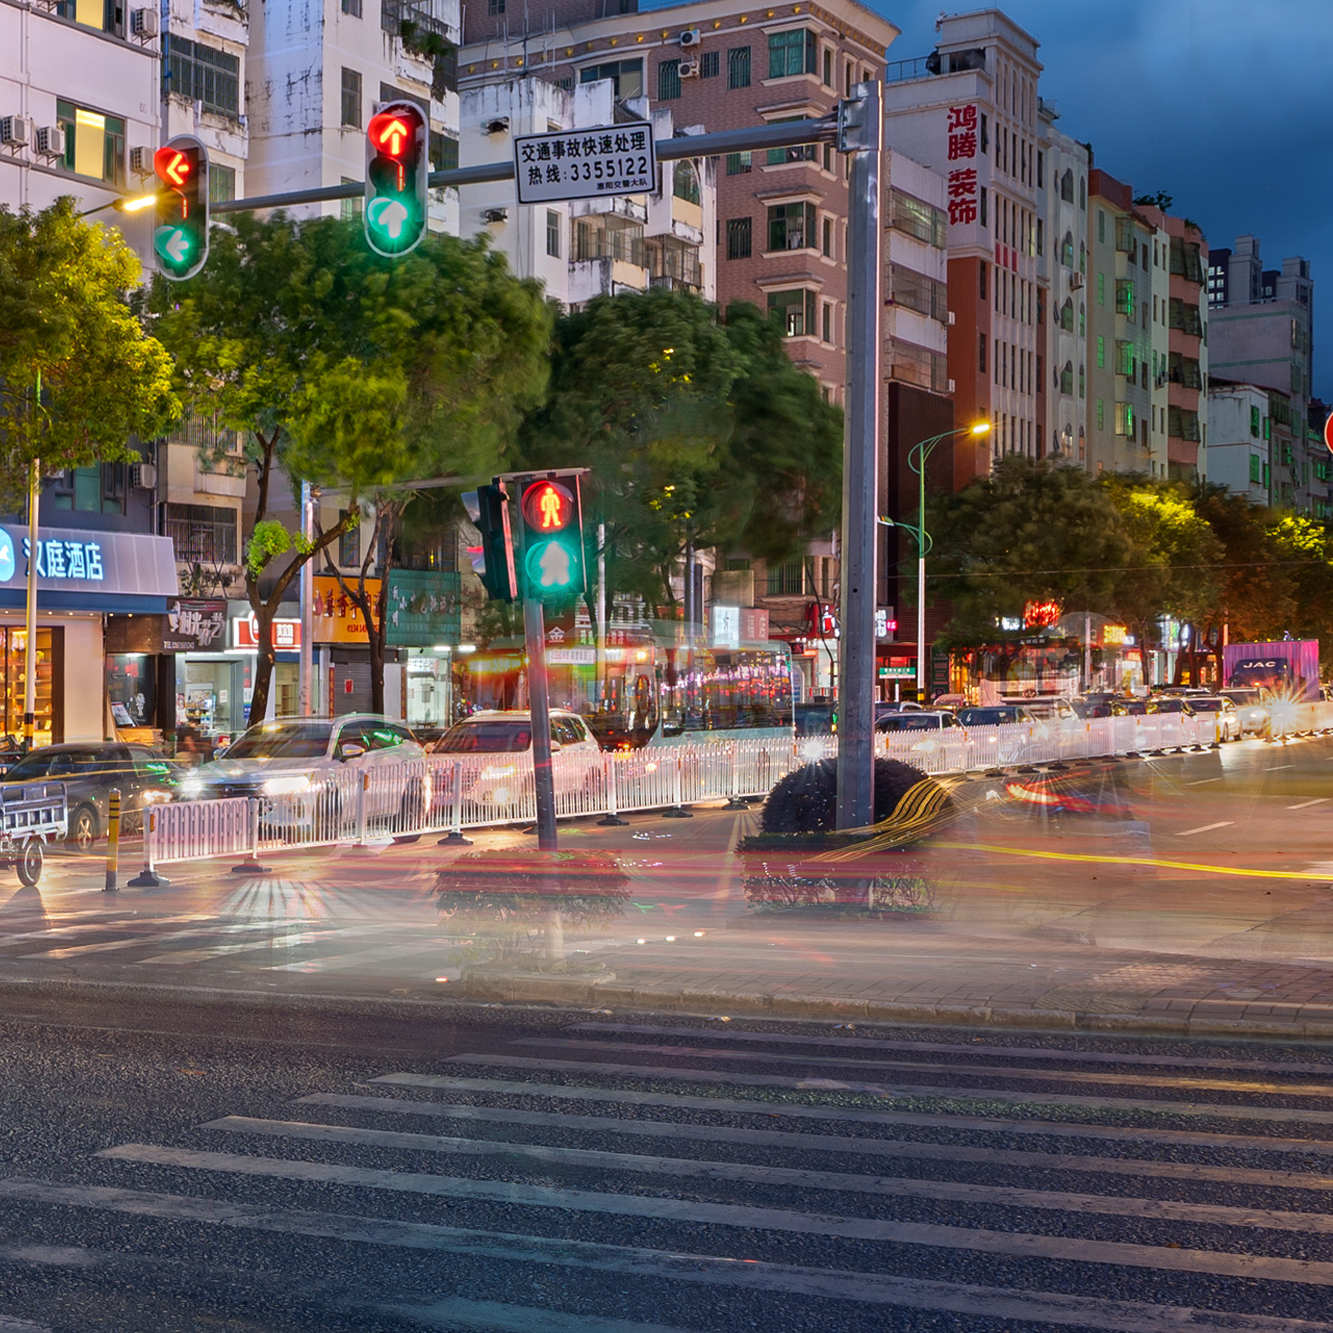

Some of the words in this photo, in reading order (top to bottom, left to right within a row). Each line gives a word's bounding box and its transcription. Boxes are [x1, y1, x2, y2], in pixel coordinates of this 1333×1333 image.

[521, 130, 647, 164] 交通事故快速处理
[946, 104, 978, 226] 鸿腾装饰
[21, 537, 104, 581] 汉庭酒店
[1242, 660, 1277, 669] JAC
